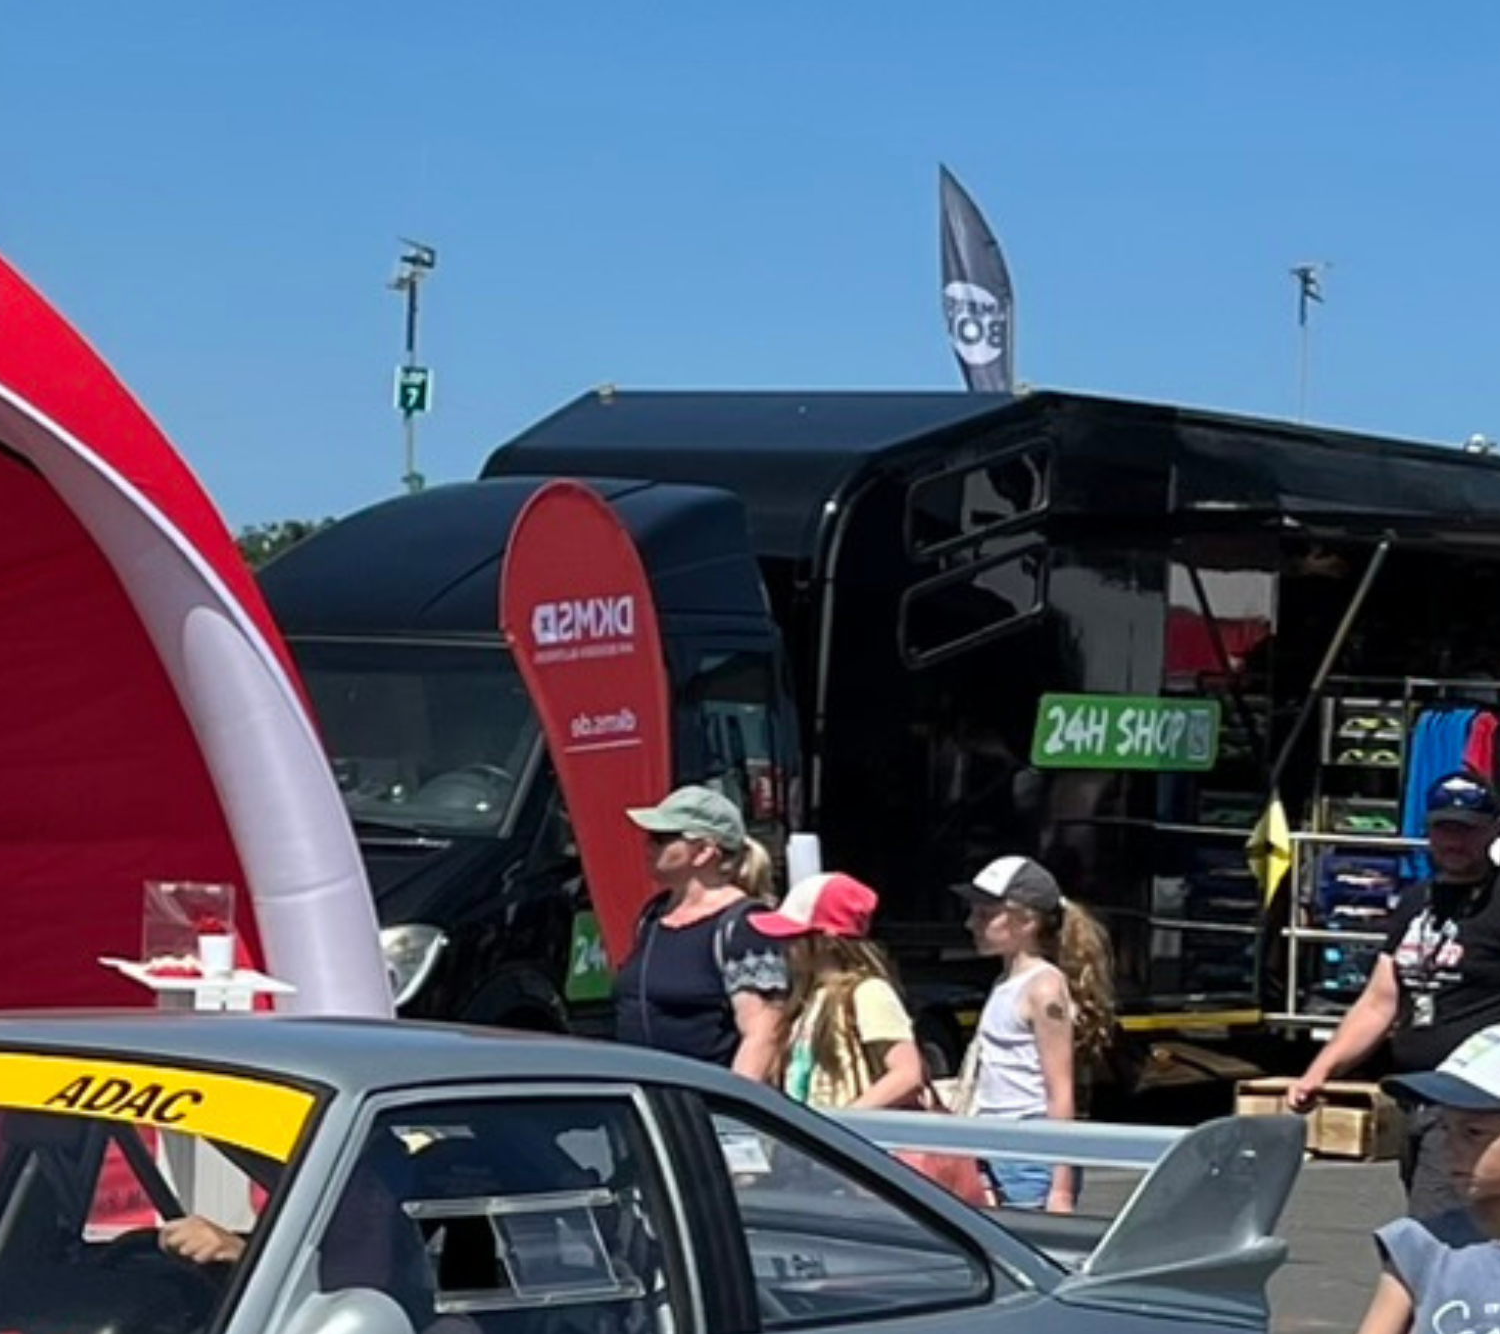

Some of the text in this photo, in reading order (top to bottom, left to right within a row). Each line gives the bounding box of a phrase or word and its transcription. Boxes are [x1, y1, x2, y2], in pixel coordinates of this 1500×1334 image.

[1044, 705, 1185, 755] 24H SHOP
[45, 1075, 204, 1124] ADAC
